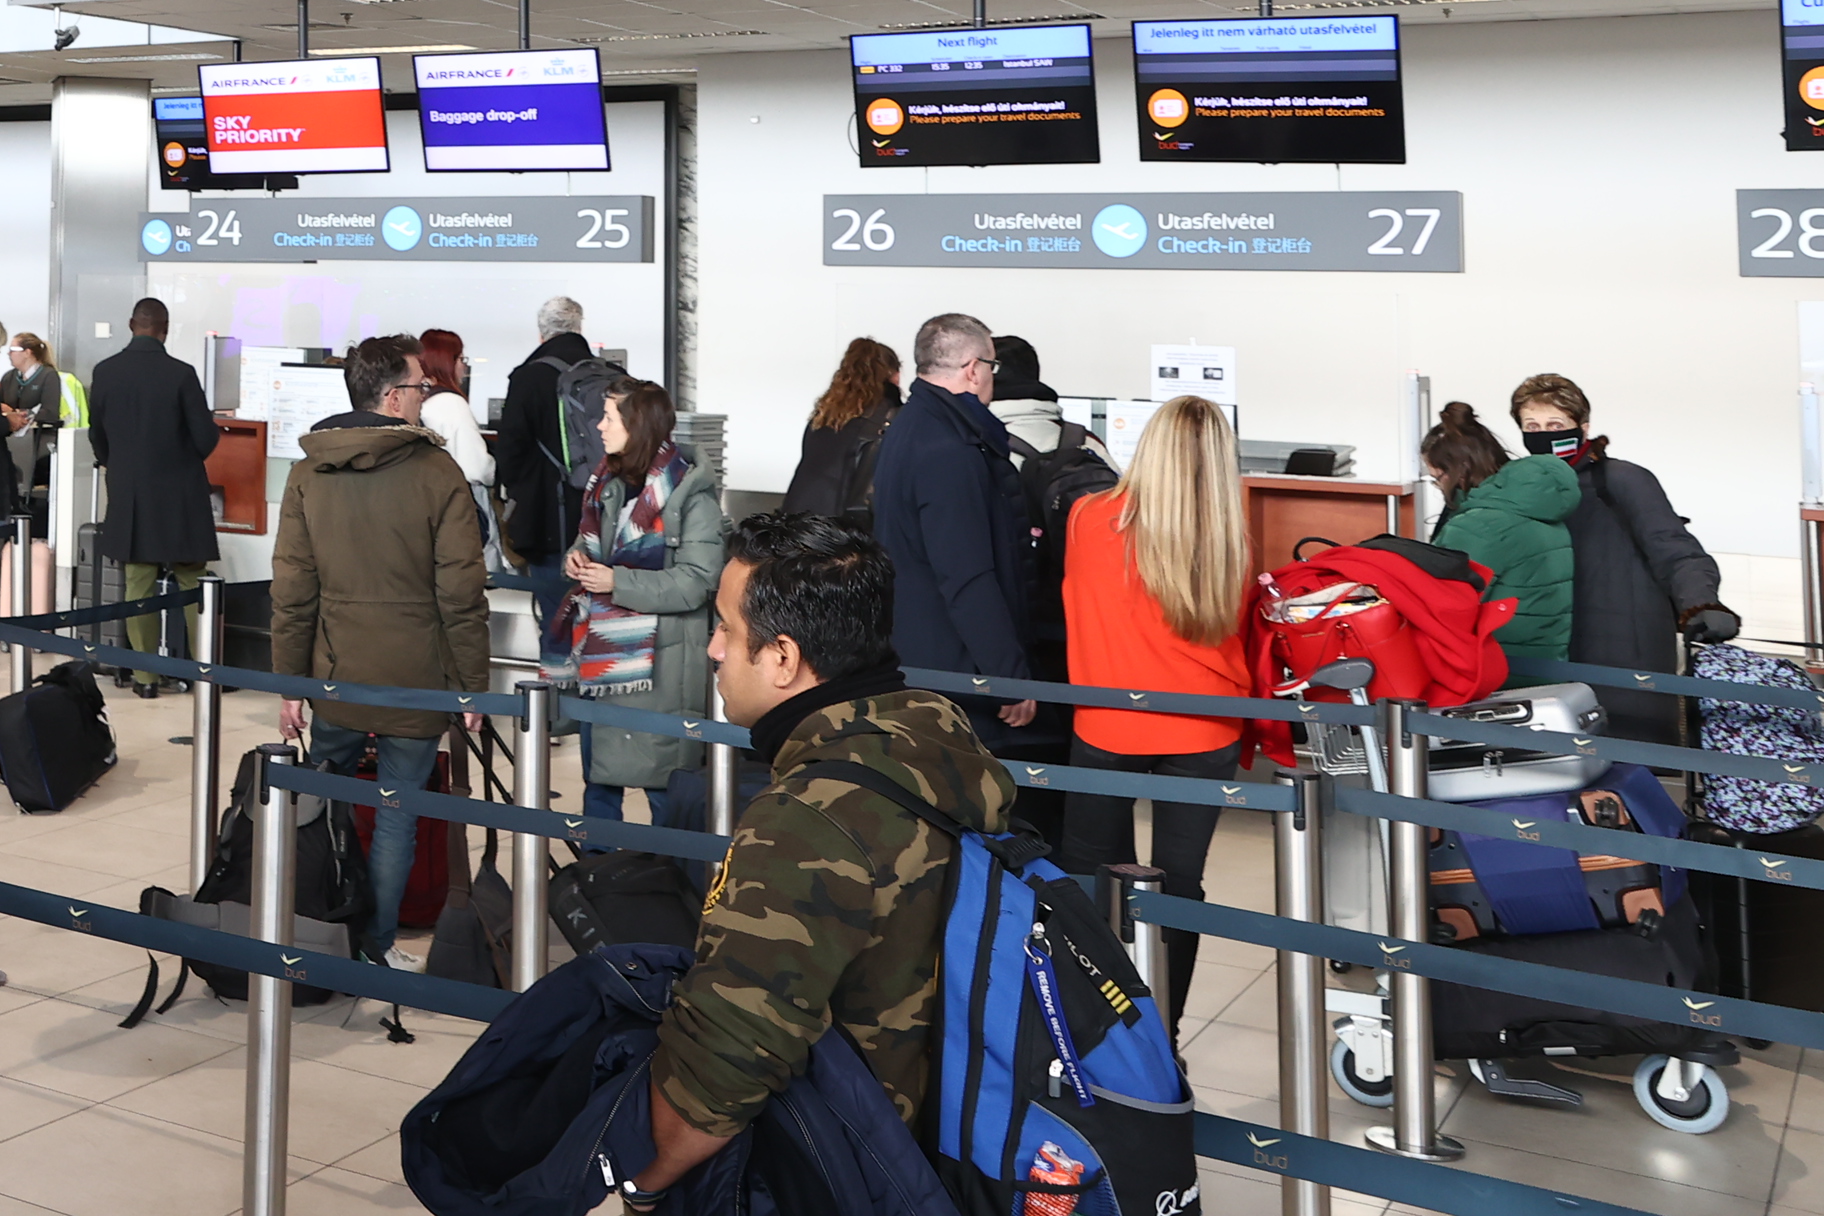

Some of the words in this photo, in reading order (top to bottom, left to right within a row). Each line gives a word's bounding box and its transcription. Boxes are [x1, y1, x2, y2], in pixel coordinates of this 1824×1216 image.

[1150, 28, 1199, 40] Jelenleg
[1202, 27, 1214, 38] itt
[1217, 28, 1245, 37] nem
[1248, 25, 1297, 37] várható
[1300, 23, 1376, 36] utasfelvétel
[938, 37, 964, 48] Next
[967, 36, 997, 48] flight
[326, 74, 356, 83] KLM
[426, 69, 502, 80] AIRFRANCE
[543, 67, 574, 76] KLM
[211, 77, 286, 88] AIRFRANCE
[430, 110, 484, 124] Baggage
[486, 108, 538, 123] drop-off
[910, 114, 940, 124] Please
[941, 115, 975, 124] prepare
[978, 114, 998, 123] your
[1000, 113, 1025, 121] travel
[1027, 111, 1081, 120] documents
[1195, 108, 1228, 117] Please
[1230, 109, 1269, 119] prepare
[1270, 109, 1293, 118] your
[1295, 108, 1324, 117] travel
[1325, 108, 1385, 117] documents
[213, 116, 251, 130] SKY
[197, 210, 242, 245] 24
[297, 212, 375, 228] Utasfelvétel
[429, 212, 512, 228] Utasfelvétel
[974, 212, 1082, 231] Utasfelvétel
[1158, 212, 1274, 231] Utasfelvétel
[576, 208, 630, 249] 25
[831, 208, 895, 253] 26
[1367, 208, 1442, 256] 27
[1750, 208, 1824, 259] 28
[274, 232, 332, 247] Check-in
[428, 232, 492, 248] Check-in
[941, 235, 1023, 254] Check-in
[1158, 236, 1248, 255] Check-in
[1036, 970, 1056, 1016] REMOVE
[1050, 1016, 1071, 1061] BEFORE
[1066, 1061, 1088, 1100] FLIGHT
[1253, 1148, 1288, 1170] bud
